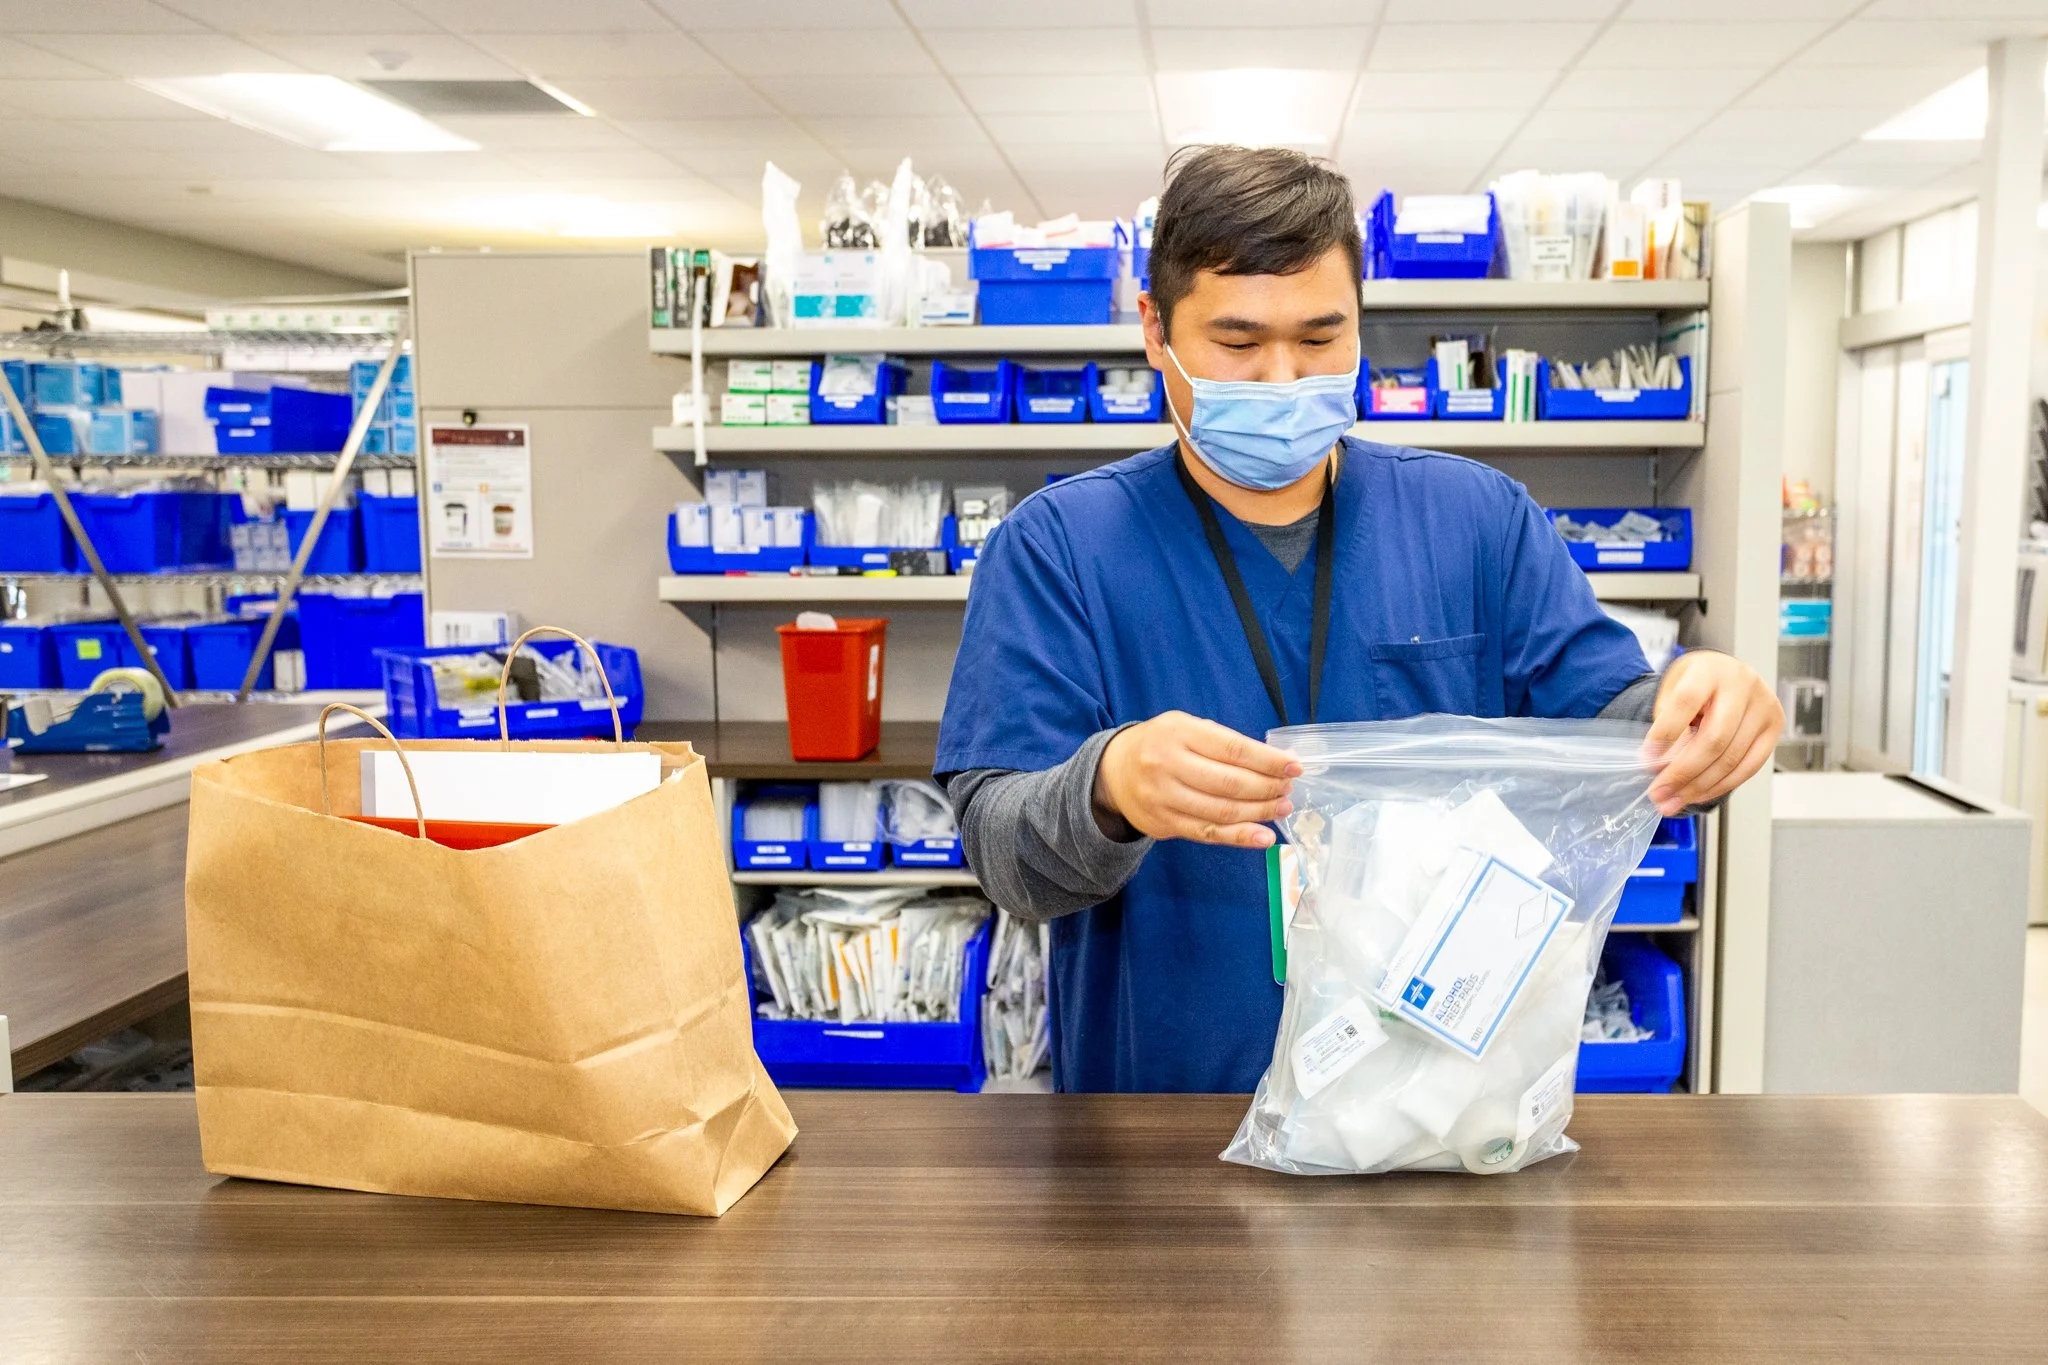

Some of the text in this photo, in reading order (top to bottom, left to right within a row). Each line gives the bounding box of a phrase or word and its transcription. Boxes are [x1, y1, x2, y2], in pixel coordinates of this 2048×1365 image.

[1433, 973, 1467, 1022] ALCOHOL
[1442, 999, 1463, 1027] PREP
[1457, 971, 1479, 1001] PADS
[1469, 1025, 1484, 1043] 100
